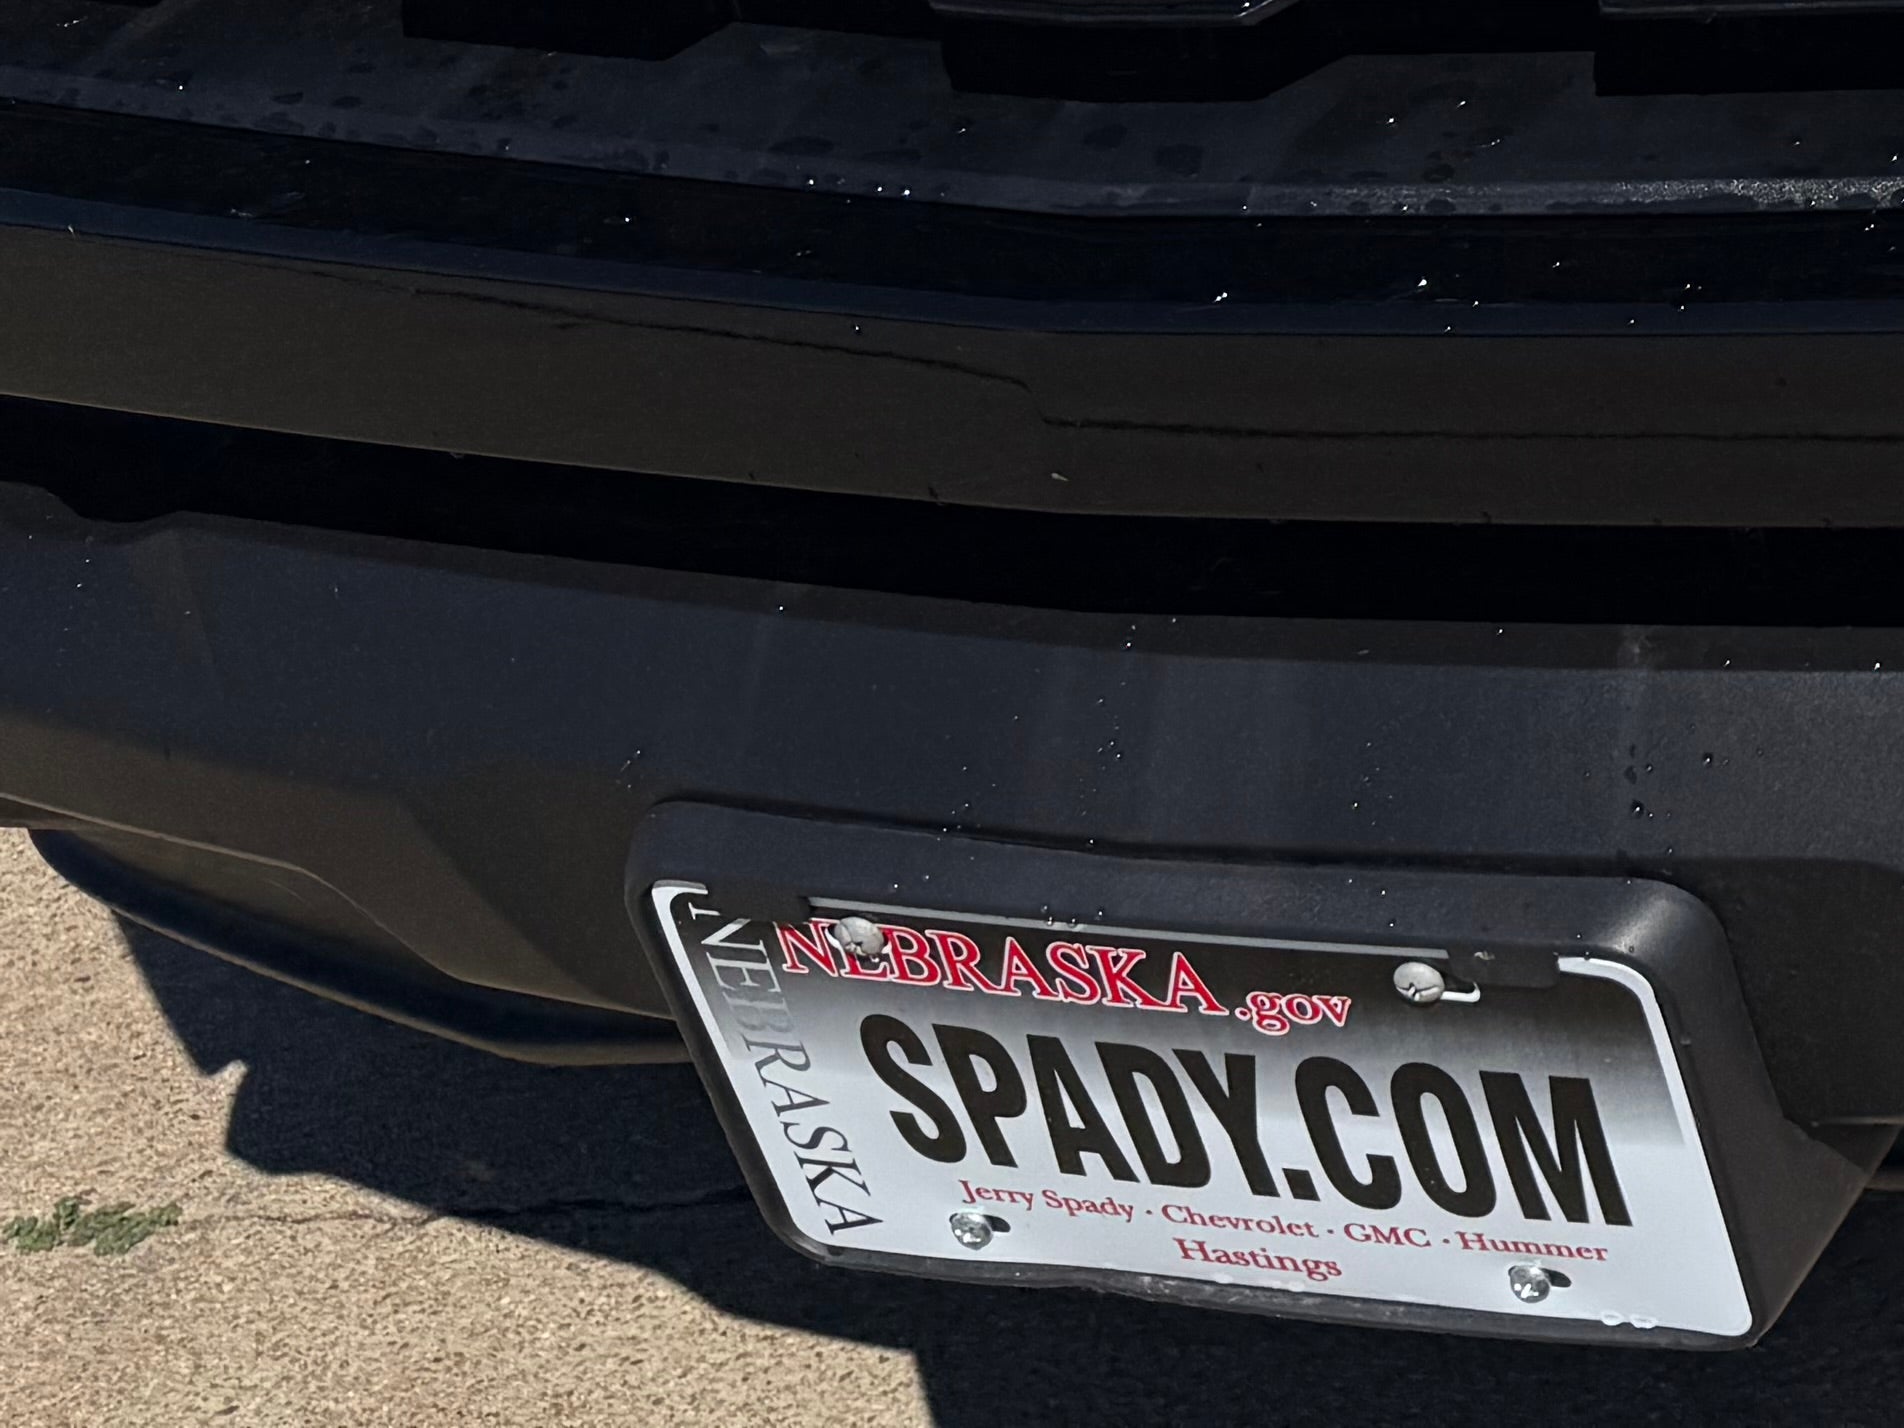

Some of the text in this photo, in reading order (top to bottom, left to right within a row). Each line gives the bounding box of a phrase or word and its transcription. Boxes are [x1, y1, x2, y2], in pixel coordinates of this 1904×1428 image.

[860, 1013, 1633, 1227] SPADY.COM
[958, 1179, 1609, 1261] Jerry Spady Chevrolet GMC Hummer
[1172, 1237, 1342, 1282] Hastings
